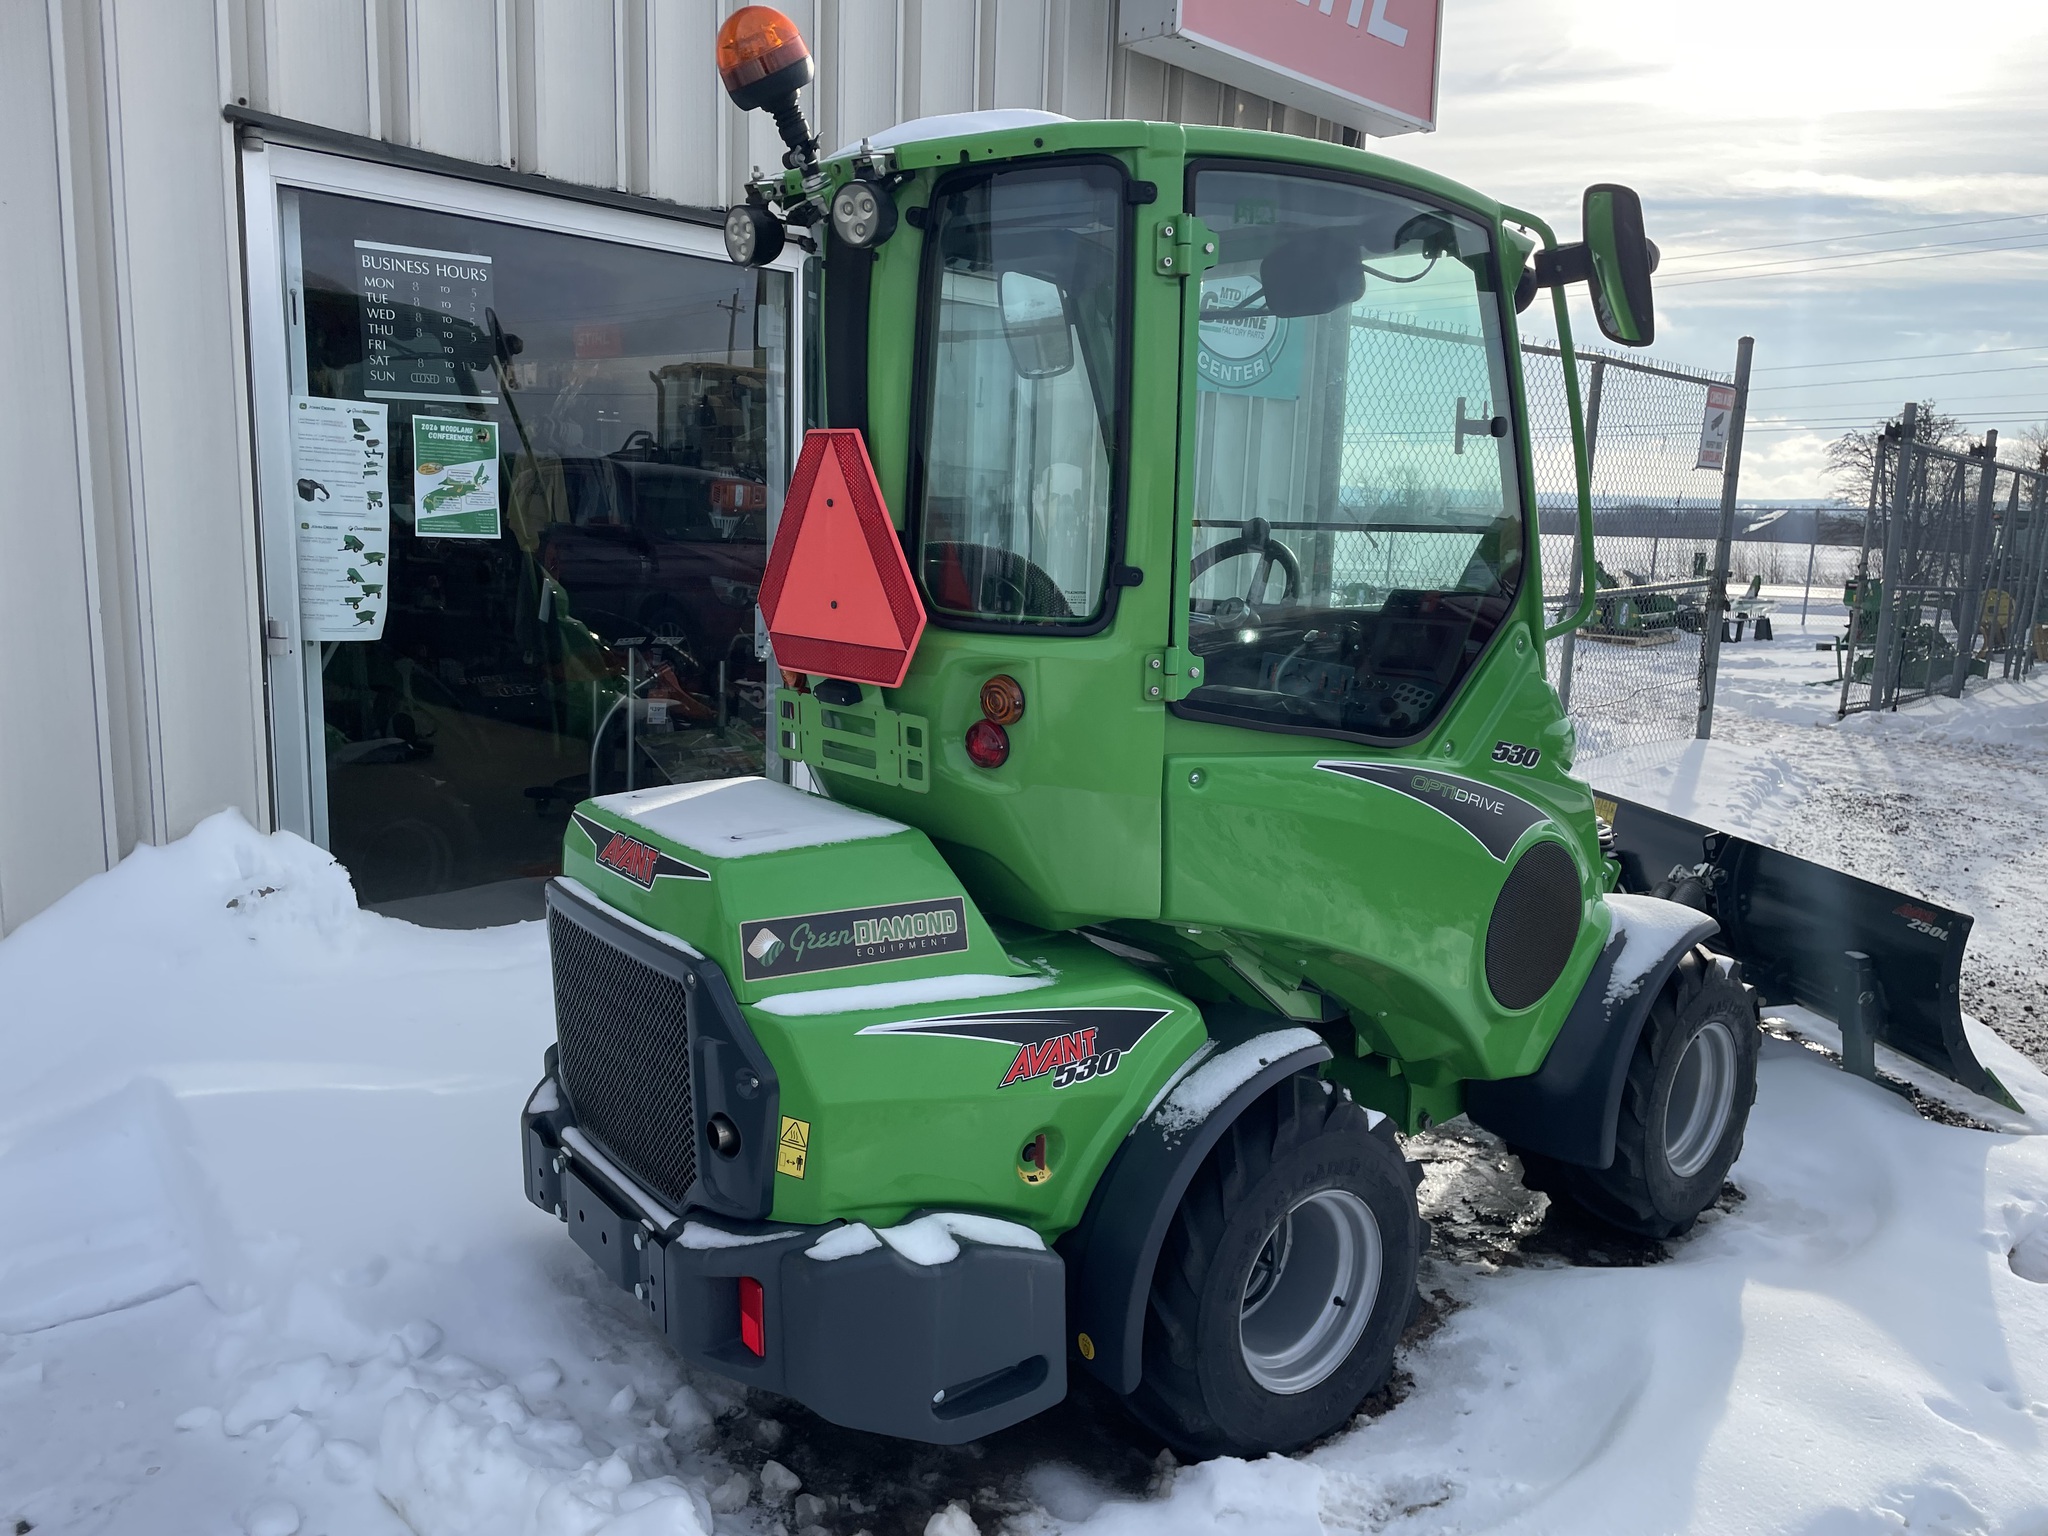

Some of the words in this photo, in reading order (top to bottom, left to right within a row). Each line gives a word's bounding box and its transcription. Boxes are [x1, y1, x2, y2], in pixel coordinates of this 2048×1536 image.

[361, 254, 430, 275] BUSINESS
[436, 263, 488, 282] HOURS
[364, 276, 395, 290] MON
[412, 281, 420, 291] 8
[440, 285, 450, 294] TO
[471, 288, 477, 298] 5
[1220, 287, 1242, 301] MTD
[365, 291, 389, 304] TUE
[413, 297, 420, 307] 8
[441, 301, 452, 309] TO
[470, 303, 476, 312] 5
[366, 307, 396, 320] WED
[415, 312, 422, 322] 8
[442, 316, 453, 324] TO
[469, 318, 476, 328] 5
[368, 323, 394, 336] THU
[416, 328, 423, 338] 8
[443, 331, 453, 339] TO
[471, 332, 477, 343] 5
[1221, 325, 1247, 337] FACTORY
[1247, 329, 1267, 340] PARTS
[368, 339, 386, 350] FRI
[444, 346, 454, 354] TO
[369, 355, 390, 366] SAT
[417, 358, 424, 368] 8
[445, 361, 455, 369] TO
[1197, 351, 1265, 381] CENTER
[370, 370, 395, 382] SUN
[411, 372, 440, 384] CLOSED
[445, 376, 455, 384] TO
[428, 432, 473, 442] CONFERENCES
[440, 425, 474, 434] WOODLAND
[1490, 740, 1541, 769] 530
[598, 830, 660, 885] AVANT
[856, 937, 949, 957] EQUIPMENT
[997, 1026, 1098, 1089] AVANT
[1052, 1048, 1122, 1090] 530
